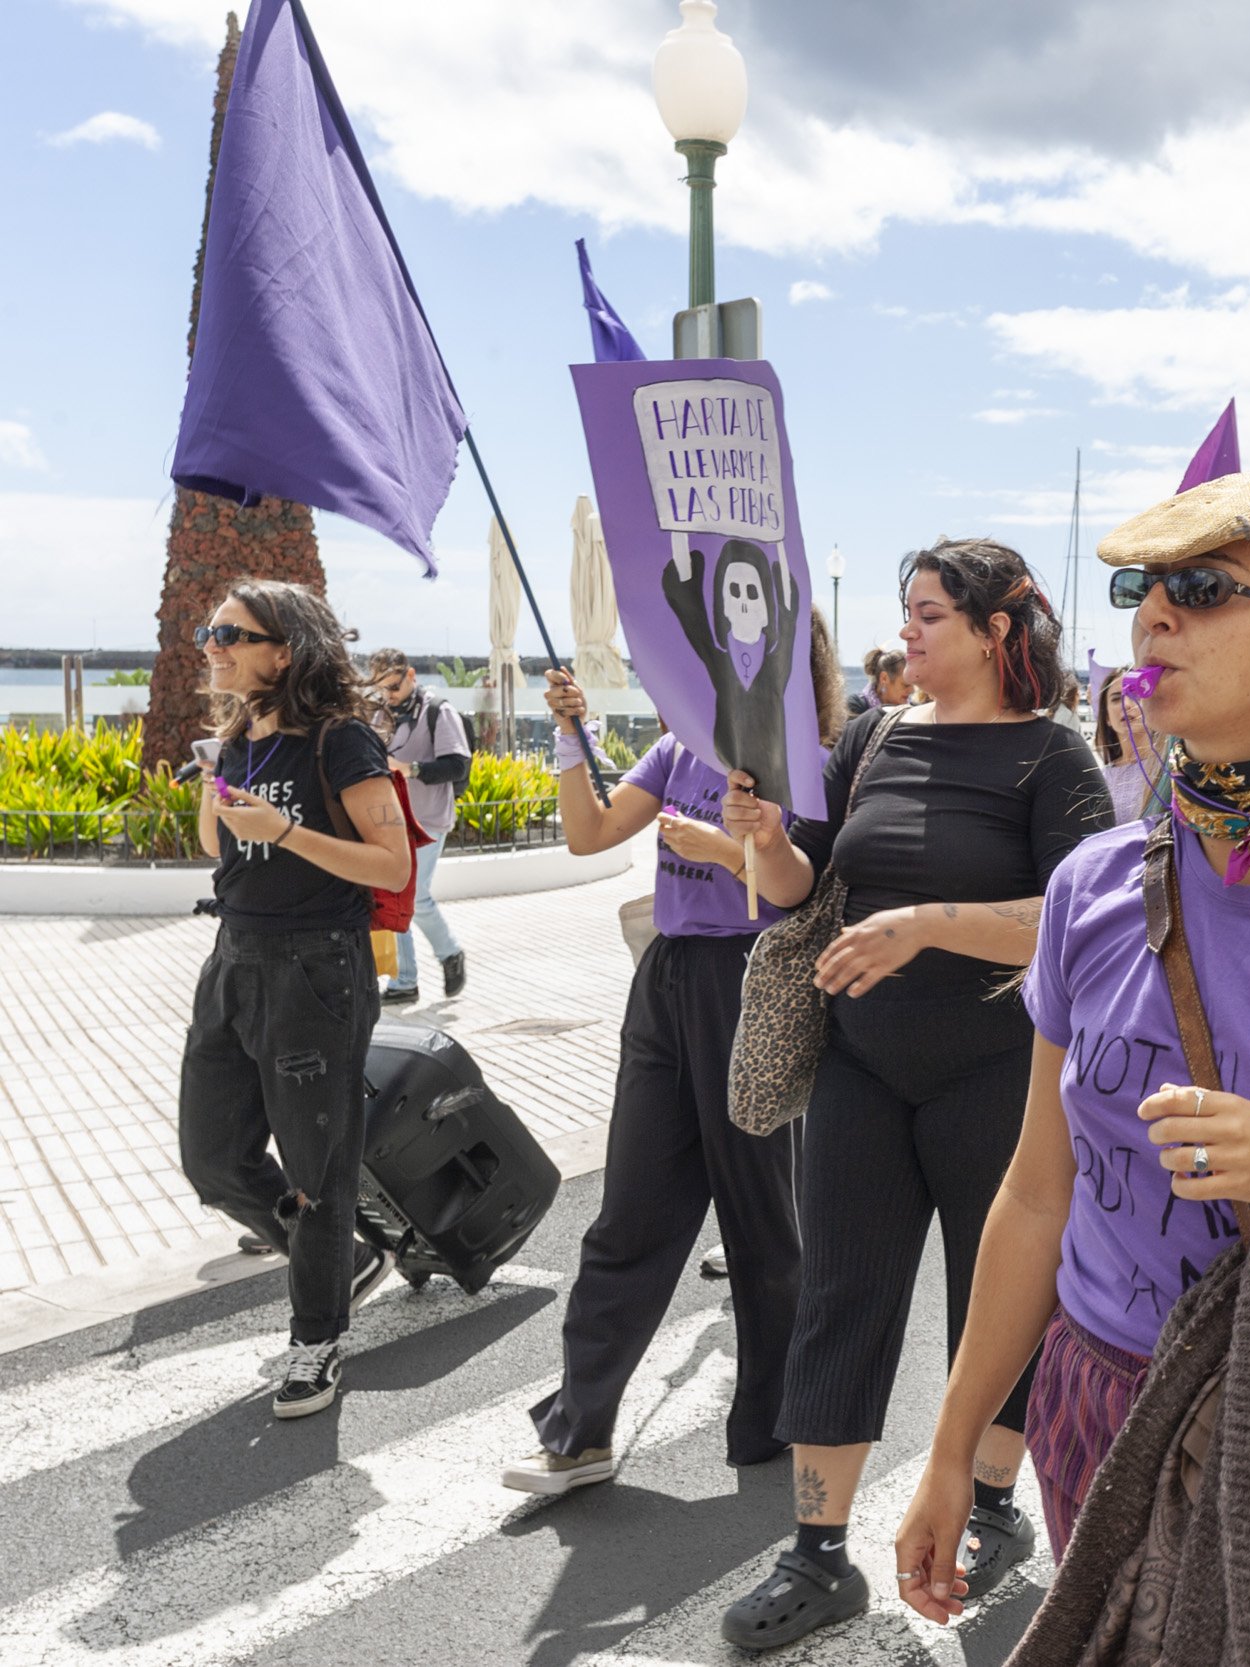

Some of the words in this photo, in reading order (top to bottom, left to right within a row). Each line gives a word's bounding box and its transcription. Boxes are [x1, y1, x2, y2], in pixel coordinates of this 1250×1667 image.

[652, 397, 743, 440] HARTA
[746, 398, 769, 441] DE
[668, 448, 756, 482] LLEVARME
[759, 452, 773, 486] A
[667, 484, 720, 523] LAS
[729, 486, 780, 531] PIBAS
[1064, 1027, 1172, 1099] NOT
